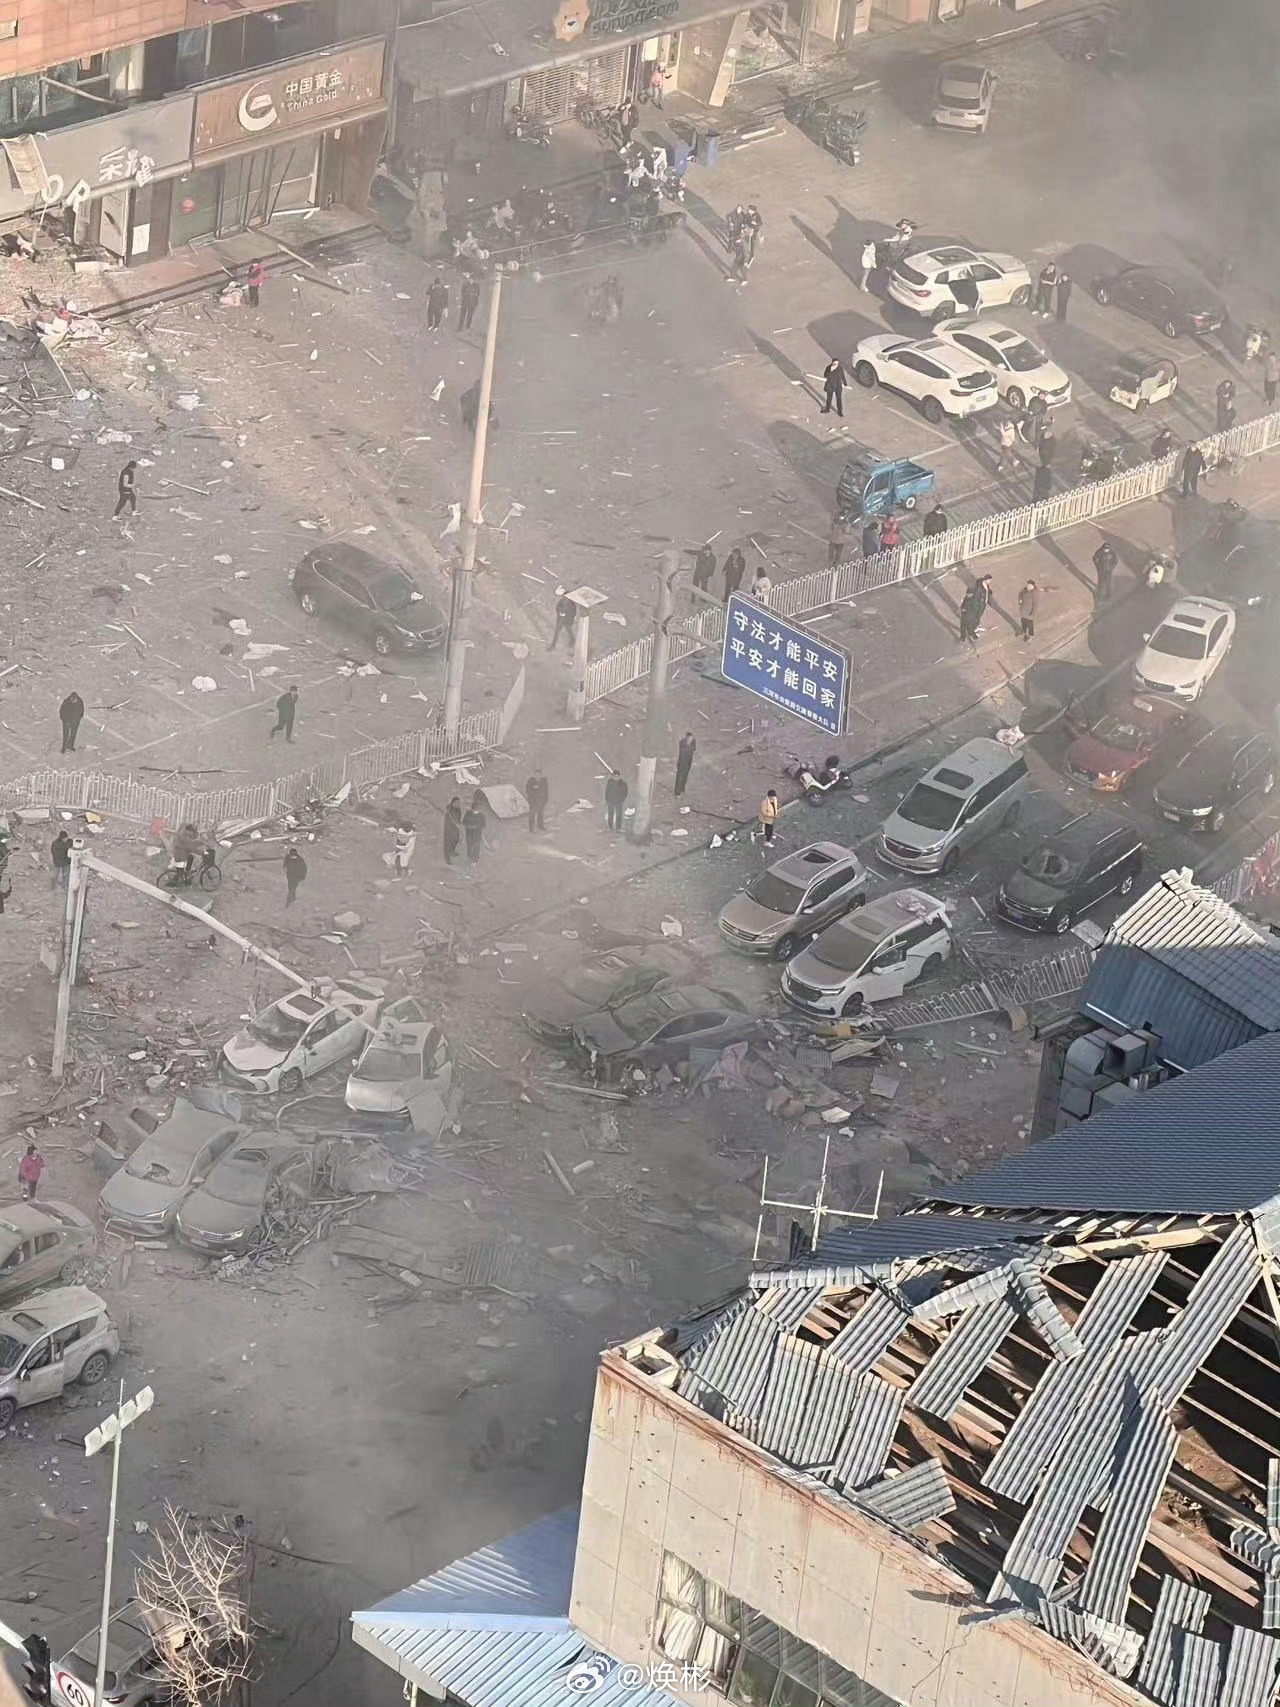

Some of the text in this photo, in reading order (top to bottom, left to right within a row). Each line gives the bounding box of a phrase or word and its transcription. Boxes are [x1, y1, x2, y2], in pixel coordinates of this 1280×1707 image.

[285, 69, 343, 98] 中国黄金
[316, 89, 337, 104] Gold
[733, 610, 838, 682] 守法才能平安
[730, 637, 836, 709] 平安才能回家
[67, 1684, 83, 1705] 60
